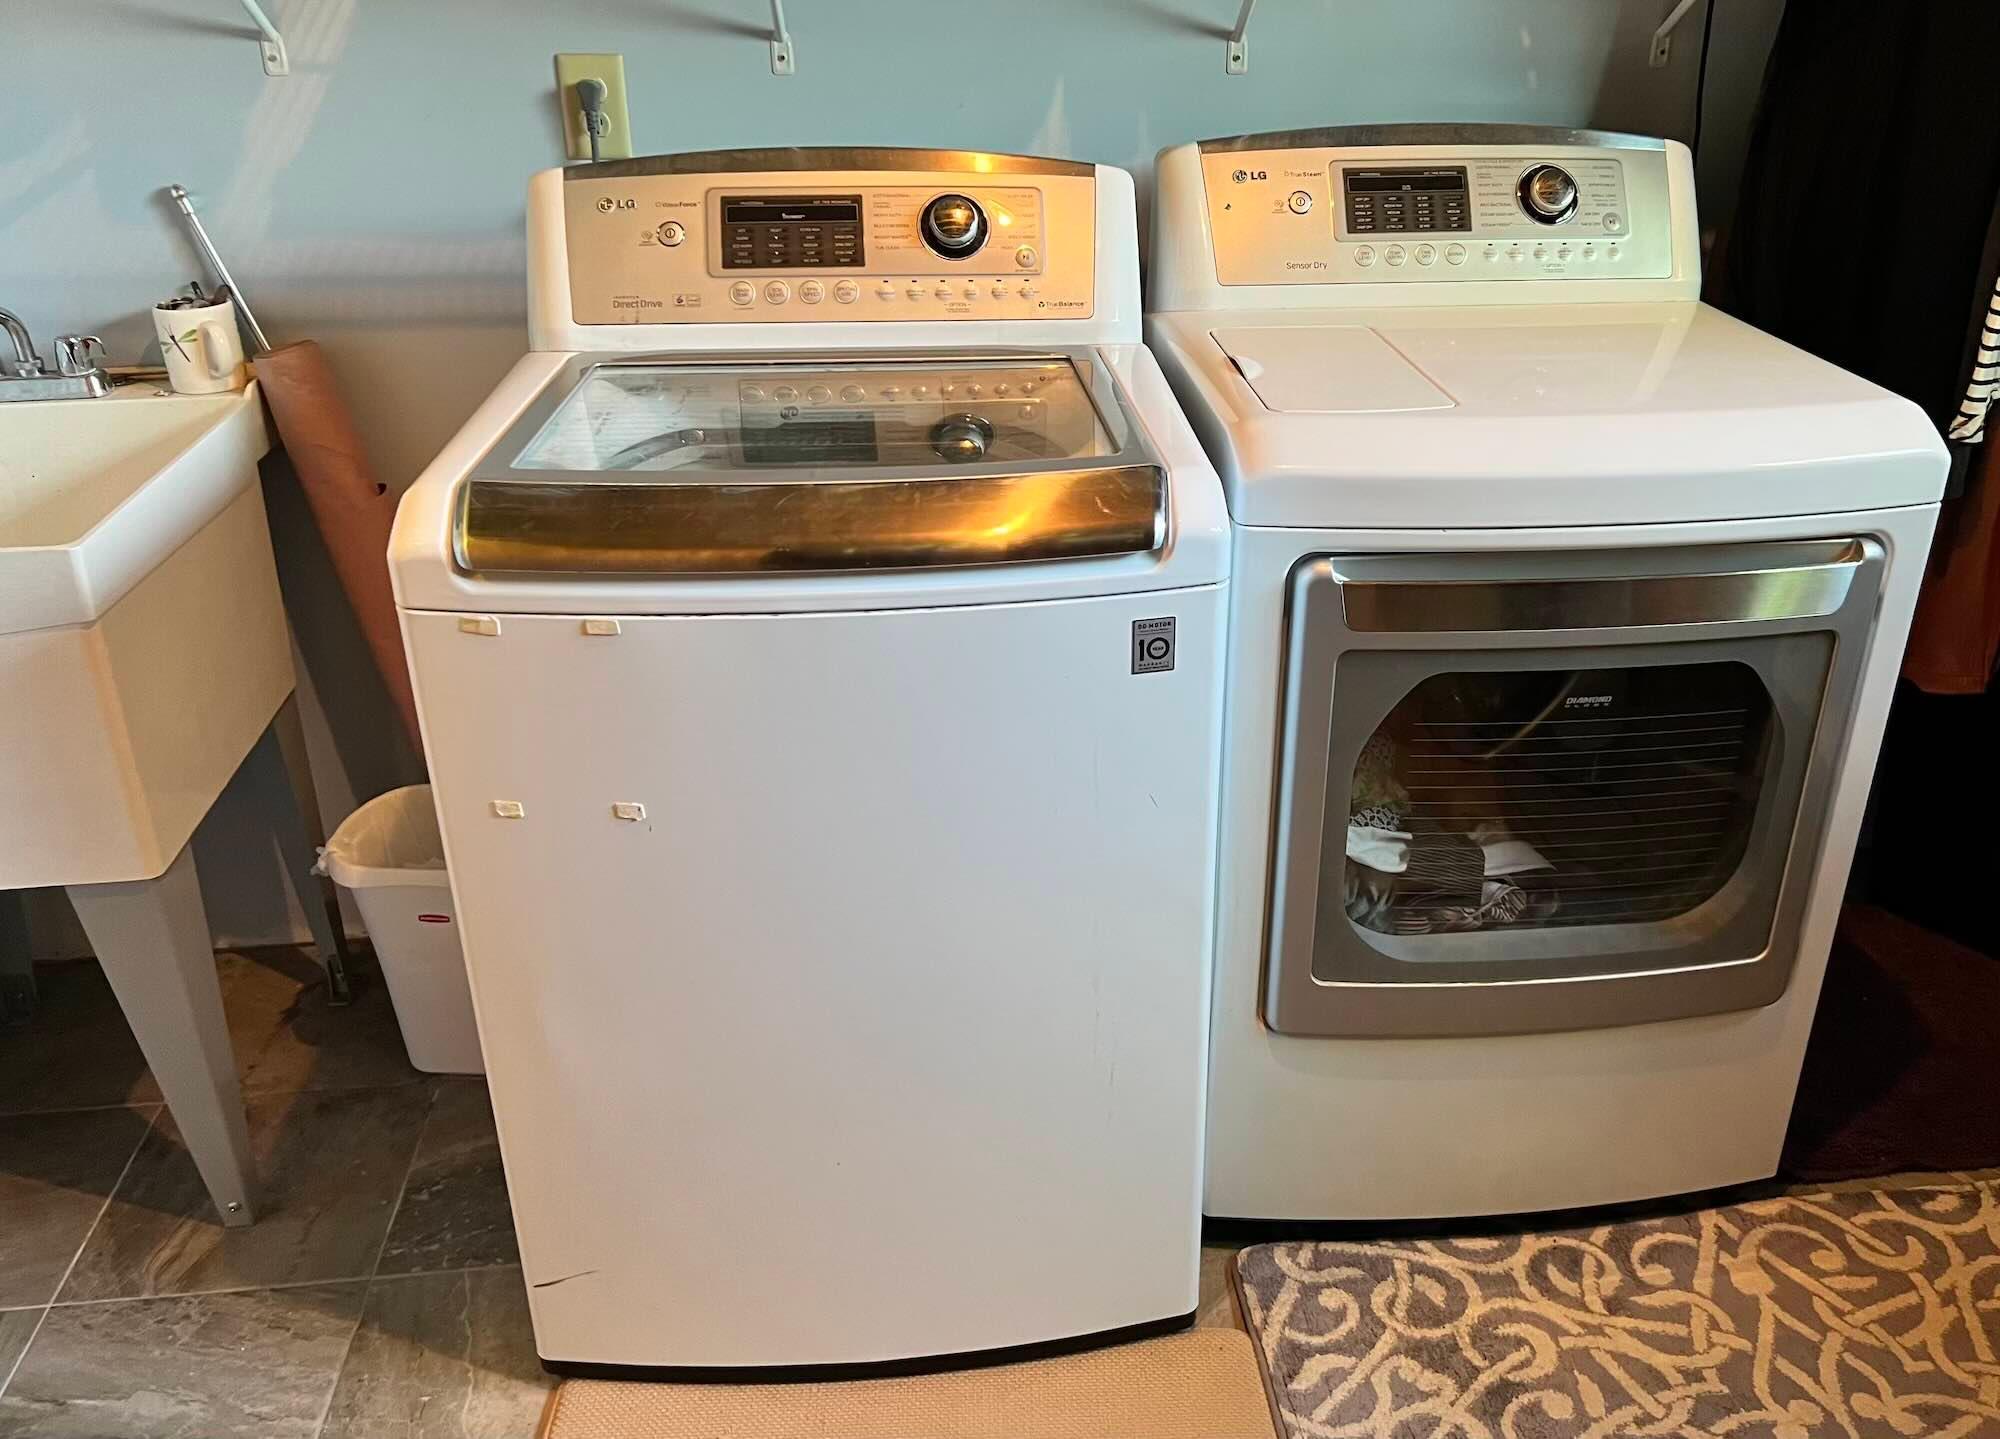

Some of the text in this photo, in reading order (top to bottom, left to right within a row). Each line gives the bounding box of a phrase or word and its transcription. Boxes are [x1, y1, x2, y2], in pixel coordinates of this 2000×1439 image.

[1250, 171, 1267, 180] LG
[617, 199, 636, 209] LG
[1286, 261, 1328, 270] Sensor Dry
[1138, 637, 1169, 661] 10
[1566, 696, 1612, 705] DIAMOND
